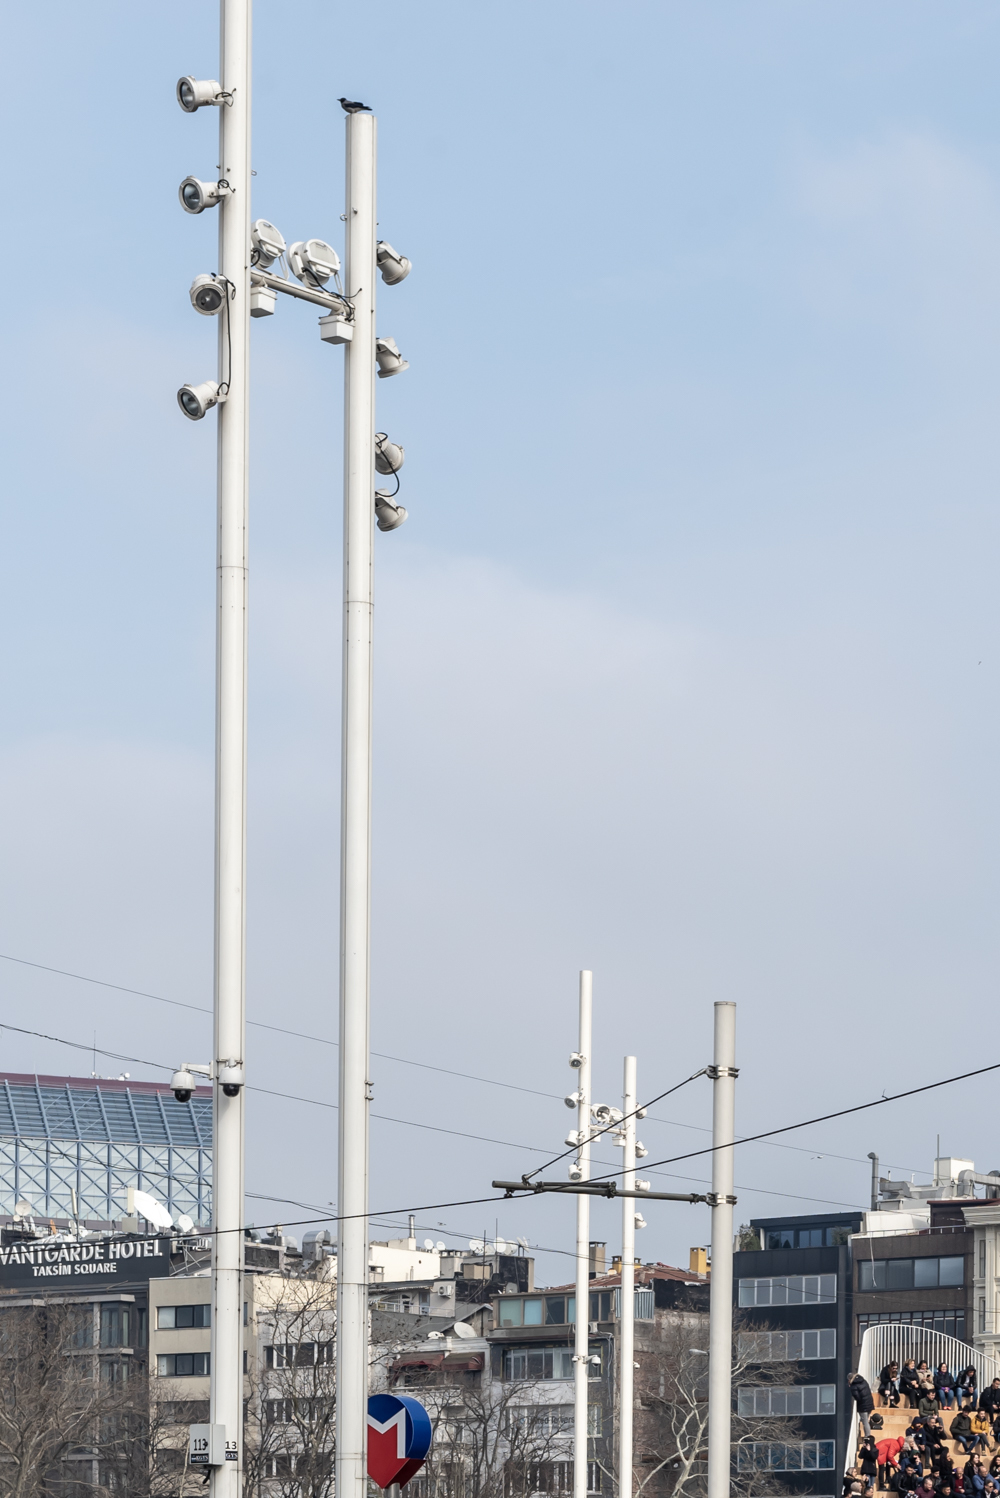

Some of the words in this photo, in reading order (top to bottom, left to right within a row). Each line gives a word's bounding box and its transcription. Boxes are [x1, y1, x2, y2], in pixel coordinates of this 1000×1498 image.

[108, 1239, 163, 1259] HOTEL
[32, 1262, 71, 1277] TAKSİM
[74, 1262, 117, 1275] SQUARE
